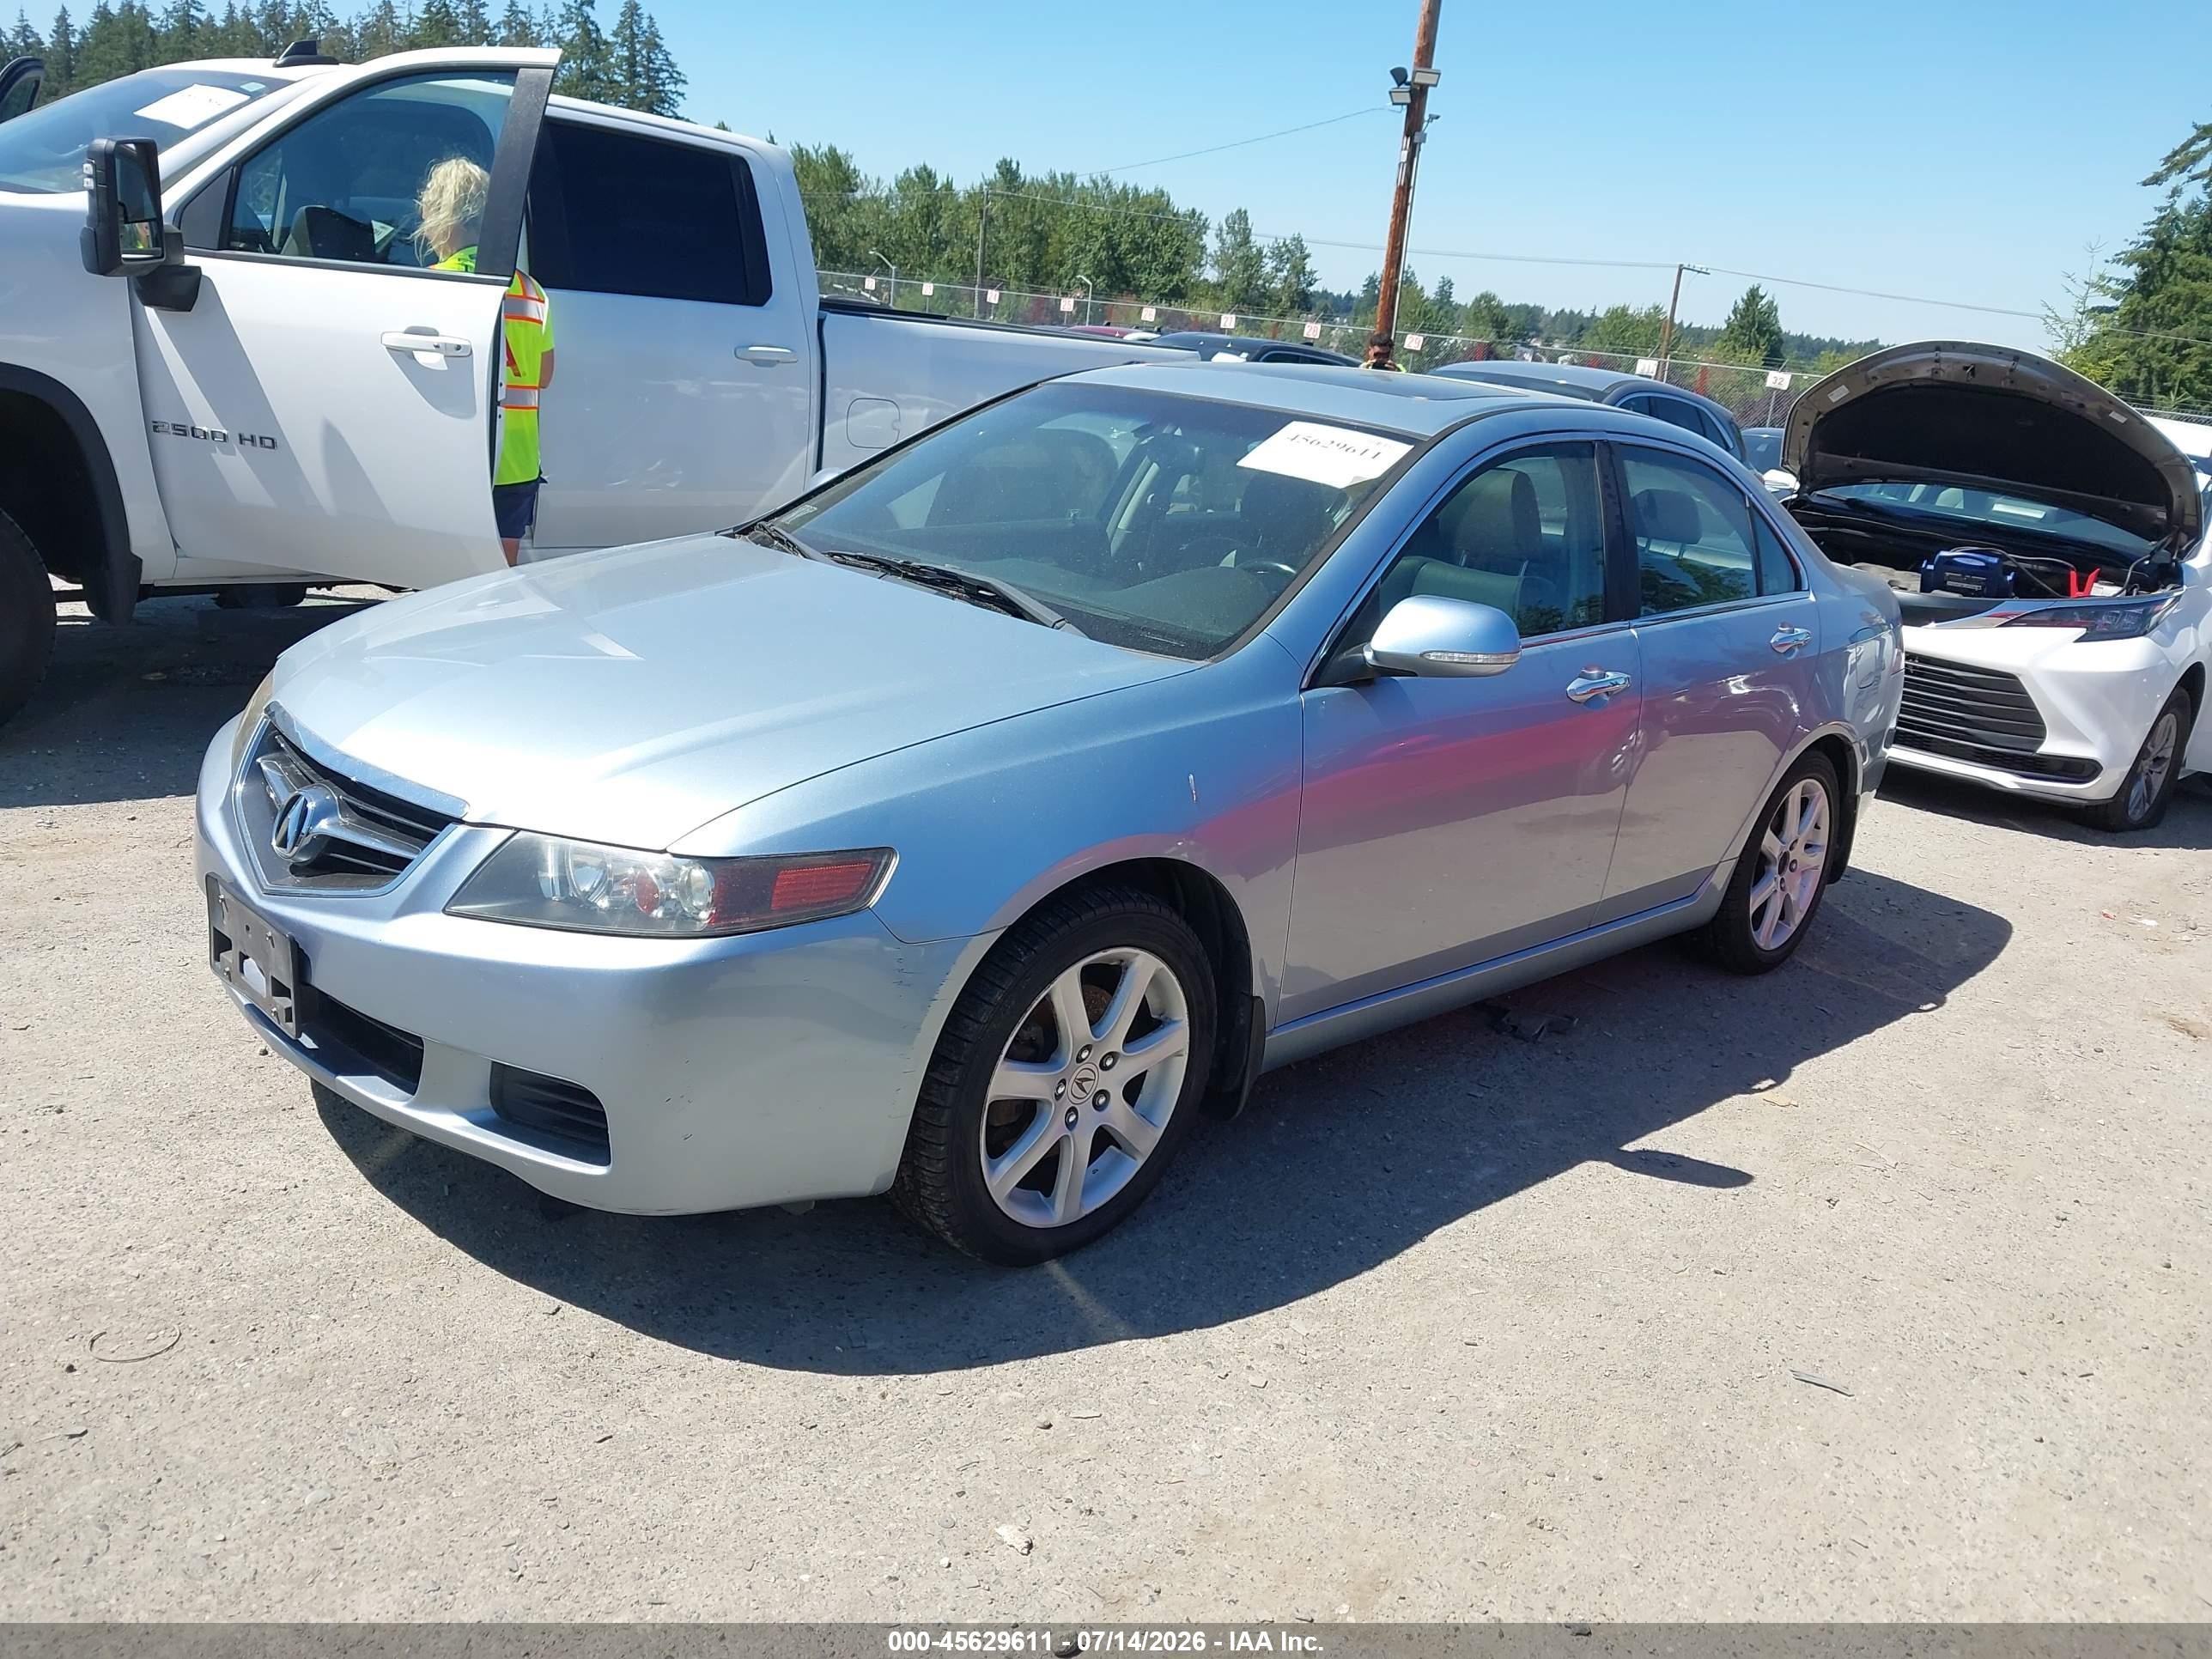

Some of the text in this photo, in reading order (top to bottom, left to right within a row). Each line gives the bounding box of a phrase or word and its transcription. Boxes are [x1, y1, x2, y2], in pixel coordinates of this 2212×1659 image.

[1406, 335, 1422, 349] 29
[1771, 375, 1785, 386] 32
[151, 420, 278, 451] 2500 HD
